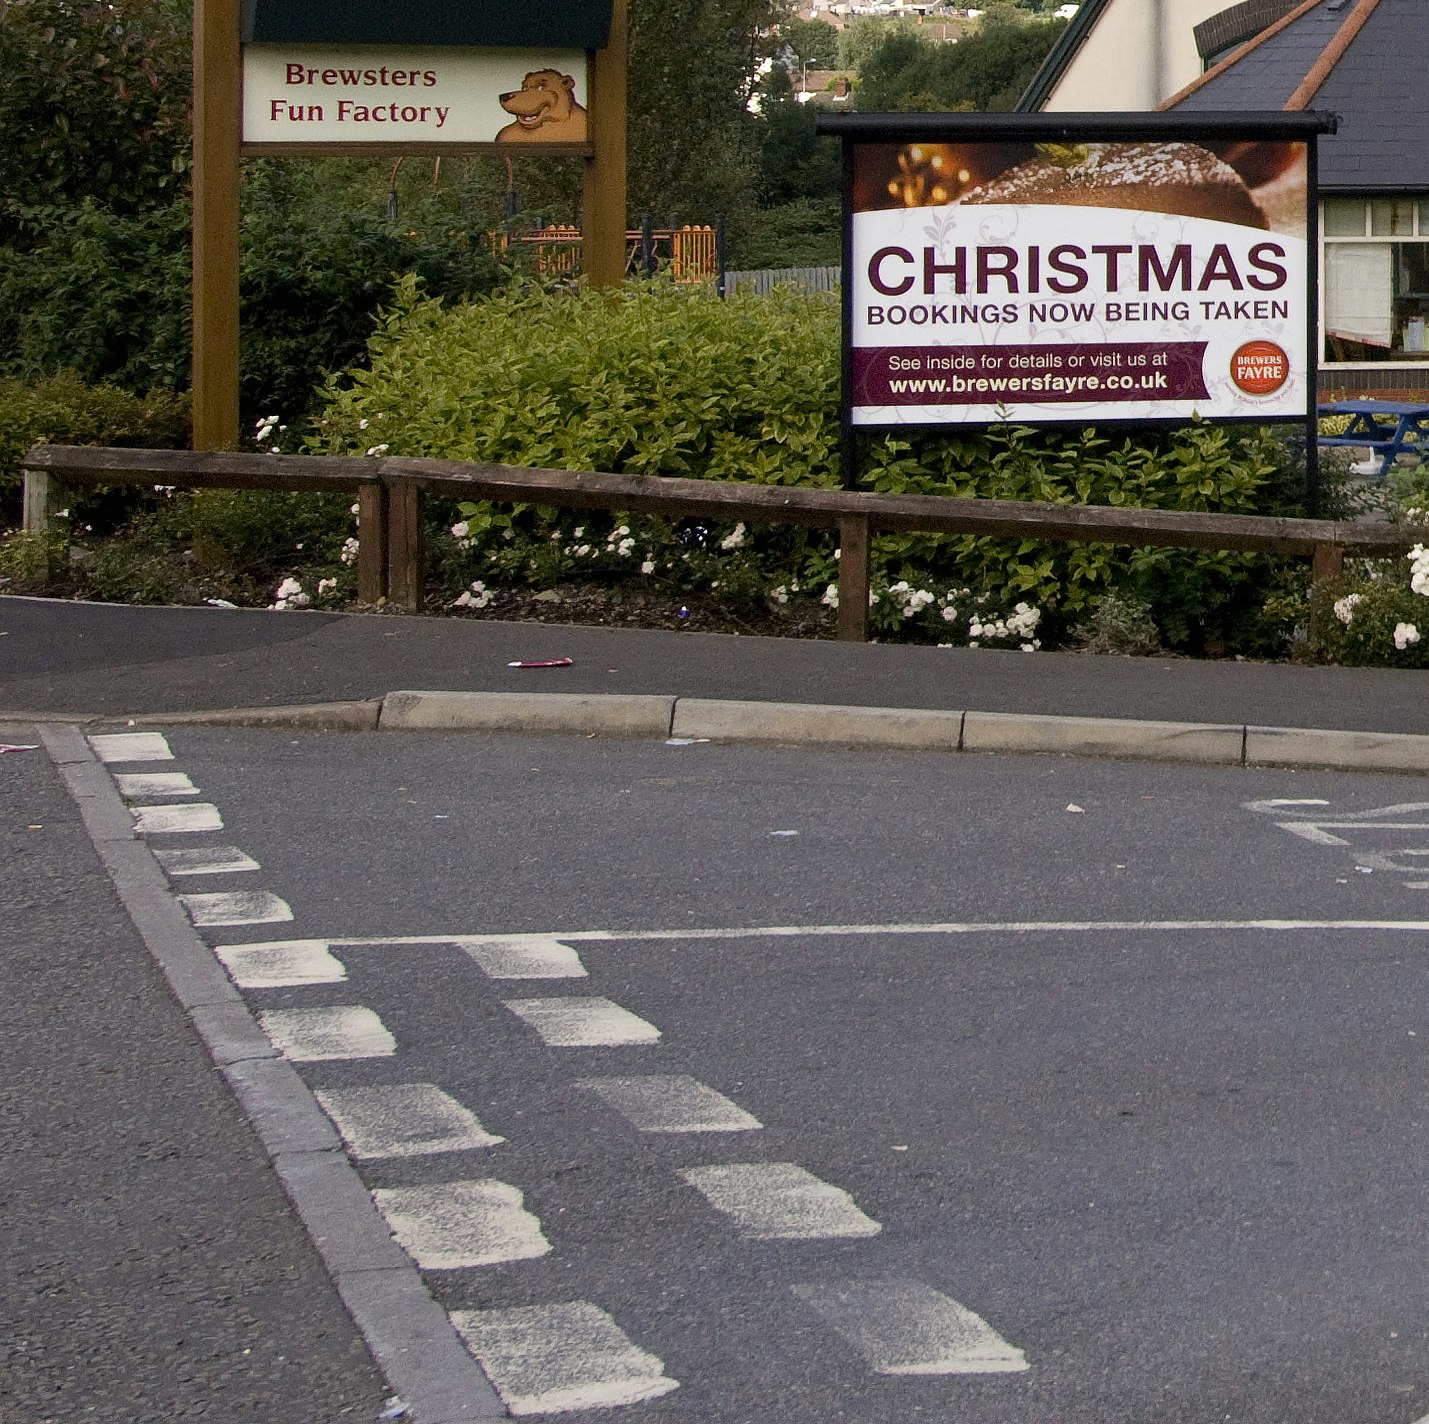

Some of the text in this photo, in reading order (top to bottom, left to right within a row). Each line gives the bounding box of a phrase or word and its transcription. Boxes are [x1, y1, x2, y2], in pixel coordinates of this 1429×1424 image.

[285, 63, 437, 87] Brewsters
[269, 99, 450, 128] Fun Factory
[867, 242, 1288, 296] CHRISTMAS
[867, 300, 1289, 326] BOOKINGS NOW BEING TAKEN
[888, 352, 1168, 371] See inside for details or visit us at
[1237, 355, 1282, 365] BREWERS
[888, 371, 1168, 394] www.brewersfayre.co.uk
[1237, 365, 1282, 380] FAYRE
